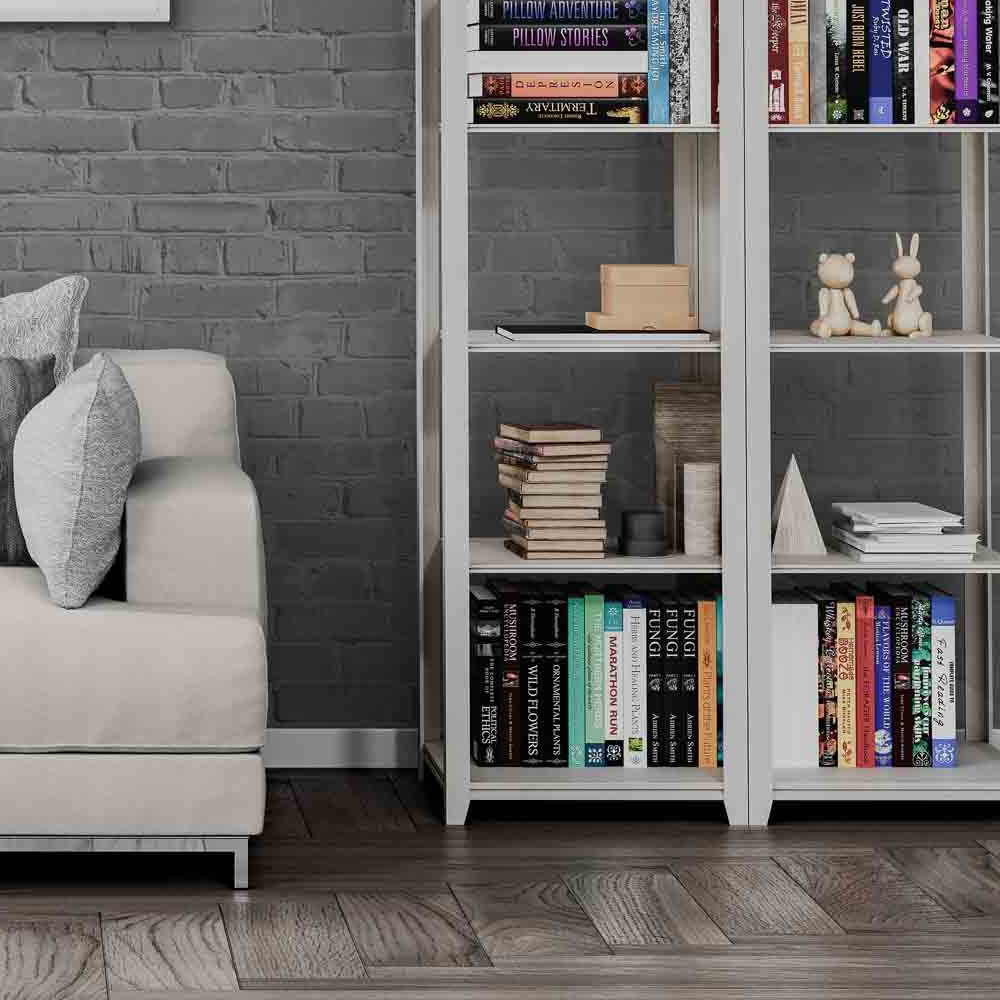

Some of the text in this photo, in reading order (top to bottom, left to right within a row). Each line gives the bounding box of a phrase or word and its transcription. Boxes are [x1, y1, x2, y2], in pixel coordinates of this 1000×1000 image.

[503, 0, 548, 19] PILLOW
[551, 0, 618, 19] ADVENTURE
[851, 4, 864, 23] JUST
[513, 28, 558, 47] PILLOW
[561, 28, 608, 47] STORIES
[852, 25, 864, 46] BORN
[880, 0, 891, 58] TWISTED
[898, 9, 909, 72] OLD WAR
[852, 50, 864, 72] REBEL
[515, 80, 616, 89] DEPRESION
[525, 102, 597, 115] TERMITARY
[509, 604, 517, 661] MUSHROOM
[630, 616, 640, 644] HERBS
[649, 609, 661, 657] FUNGI
[666, 609, 678, 657] FUNGI
[684, 609, 695, 657] FUNGI
[824, 602, 835, 643] Whiskey
[882, 621, 890, 660] FLAVORS
[900, 607, 909, 663] MUSHROOM
[609, 636, 617, 735] MARATHON RUN
[631, 665, 640, 701] HEALING
[883, 662, 890, 674] OF
[933, 638, 947, 727] Fast Reading
[528, 665, 538, 756] WILD FLOWERS
[552, 665, 560, 722] ORNAMENTAL
[481, 706, 490, 744] ETHICS
[631, 704, 640, 735] PLANTS
[912, 716, 922, 744] skills
